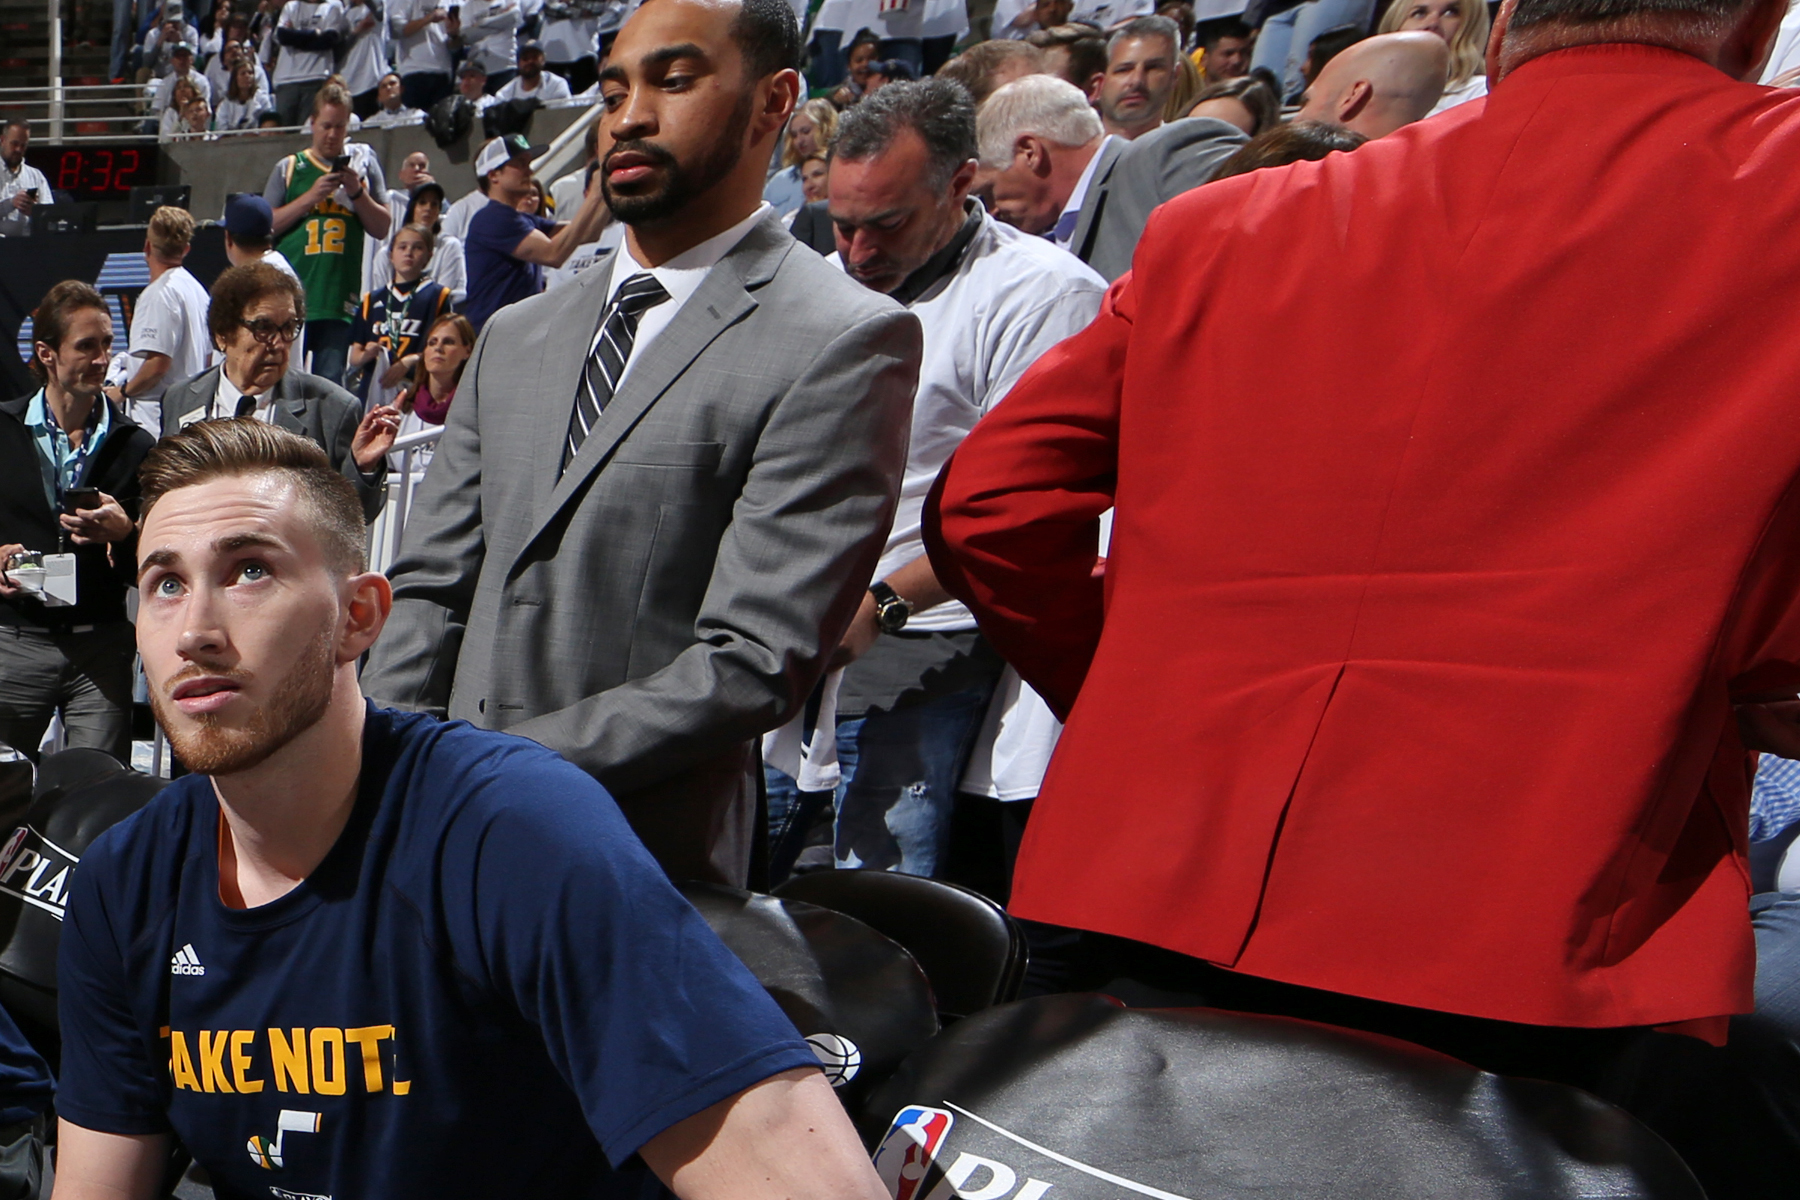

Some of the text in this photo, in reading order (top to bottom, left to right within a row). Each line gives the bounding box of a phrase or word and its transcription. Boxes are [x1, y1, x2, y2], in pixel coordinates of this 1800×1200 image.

[58, 150, 139, 191] 8:32
[304, 218, 346, 256] 12
[171, 962, 206, 976] didas
[160, 1025, 265, 1094] AKE
